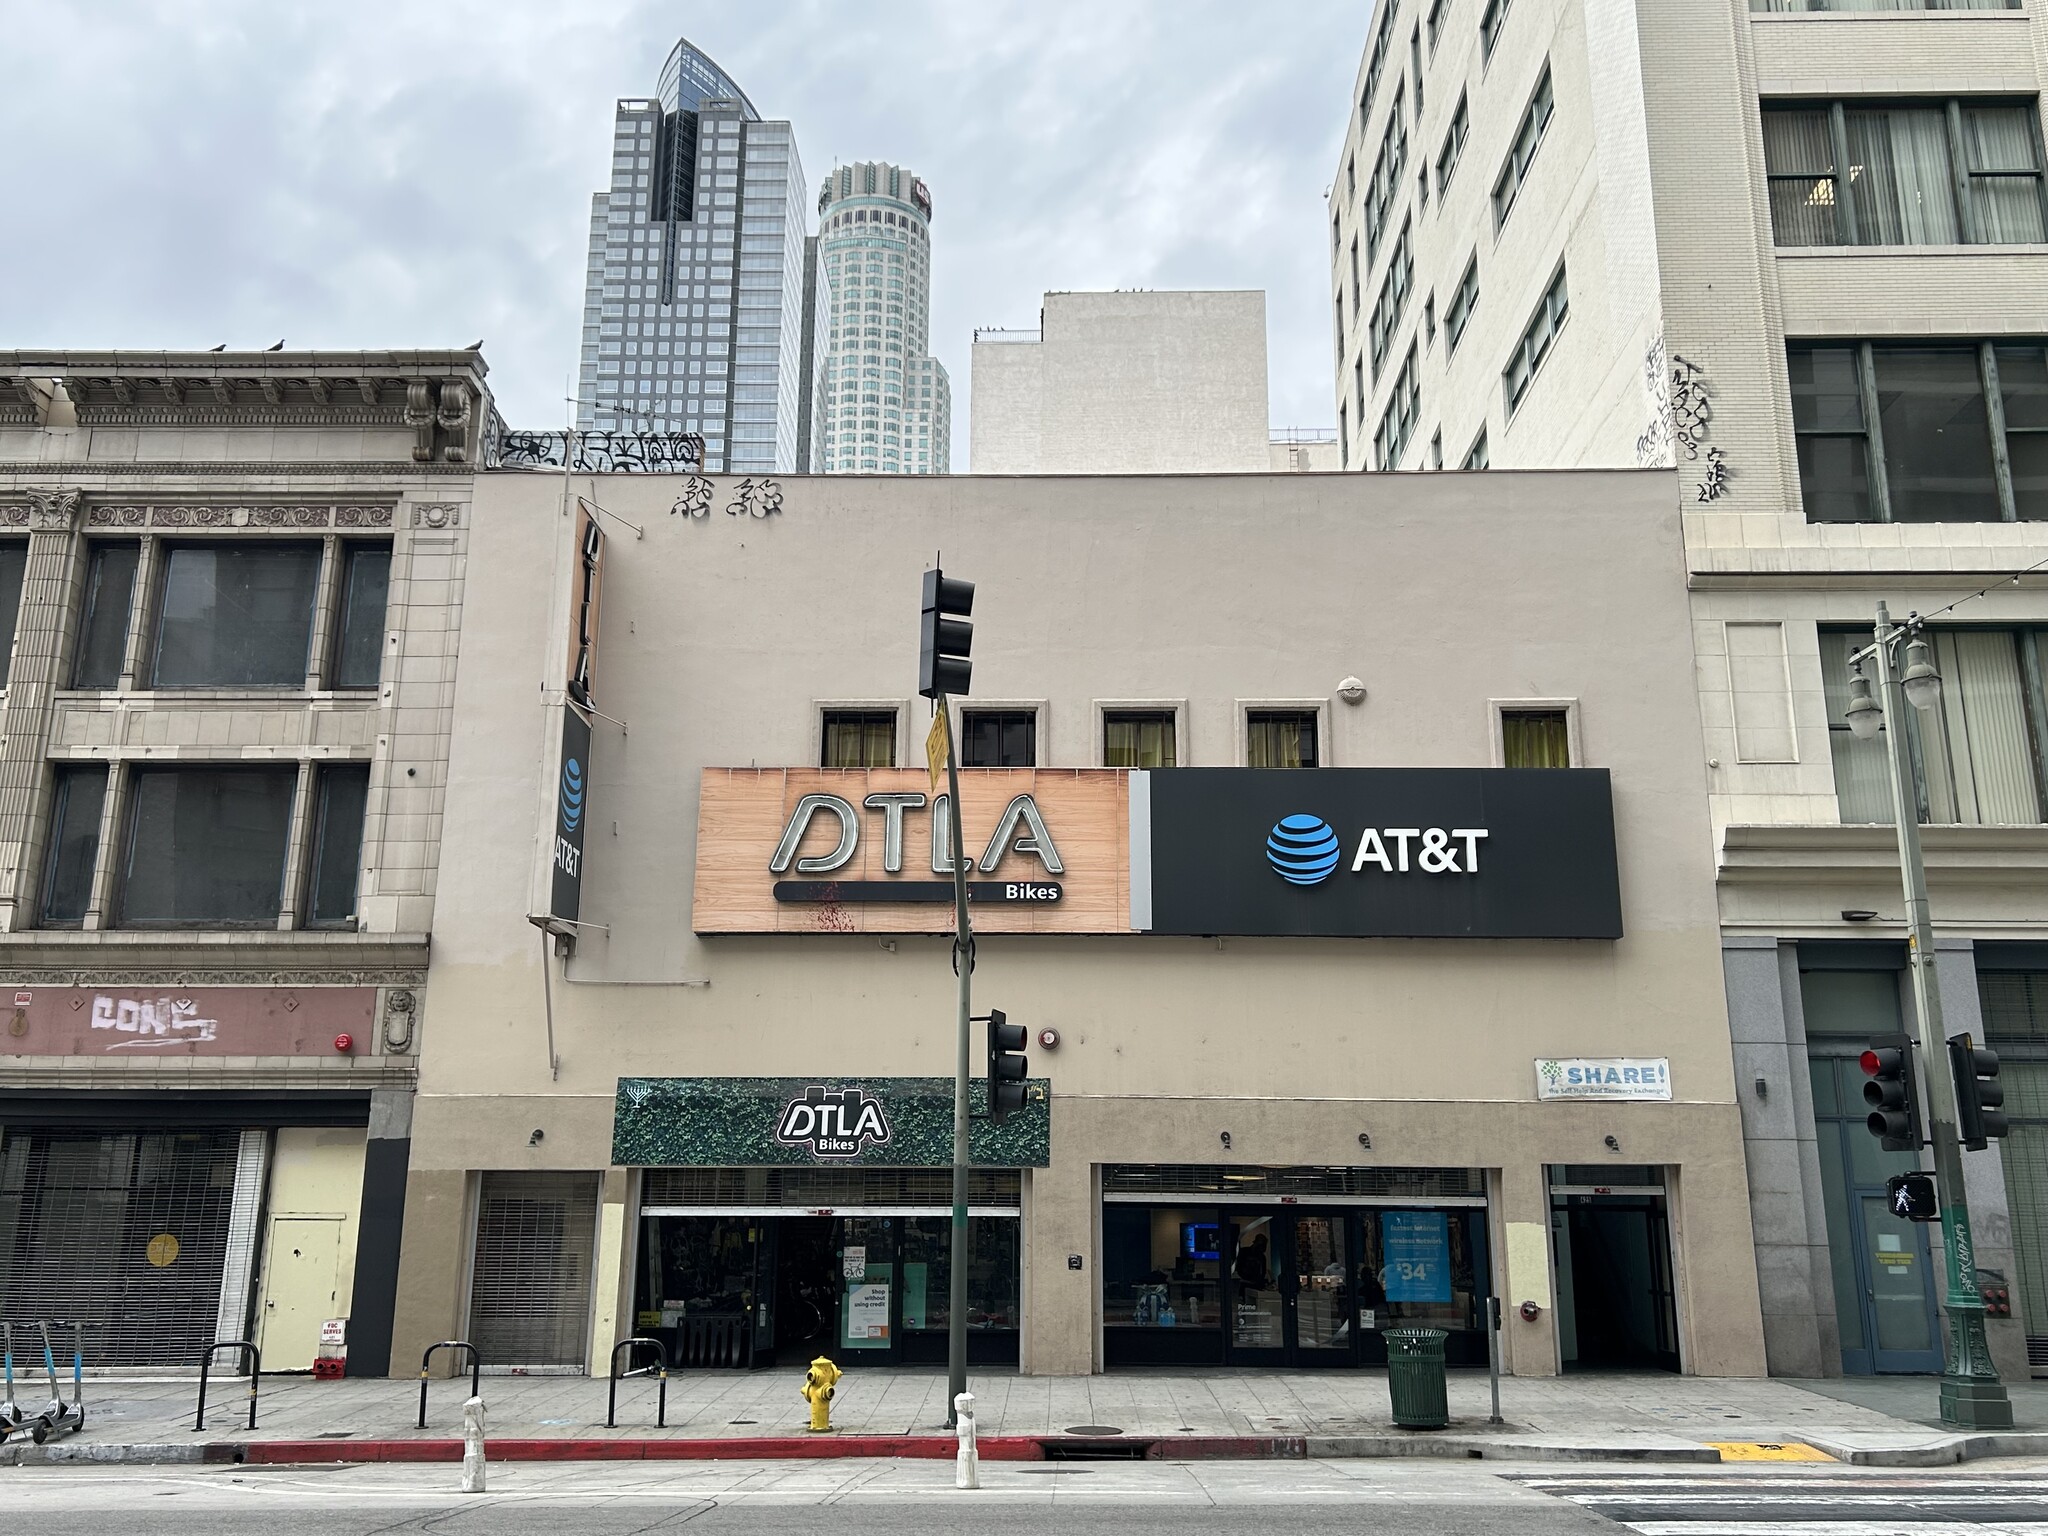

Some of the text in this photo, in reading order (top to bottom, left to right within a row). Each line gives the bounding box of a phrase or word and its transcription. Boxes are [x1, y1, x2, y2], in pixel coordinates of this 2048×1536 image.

[769, 793, 1065, 873] DTLA
[553, 834, 580, 878] AT&T
[1350, 827, 1489, 874] AT&T
[1005, 883, 1058, 899] Bikes
[1567, 1063, 1665, 1084] SHARE!
[1634, 1087, 1664, 1095] Exchange
[783, 1104, 884, 1136] DTLA
[819, 1138, 855, 1150] Bikes
[1396, 1262, 1426, 1280] $34
